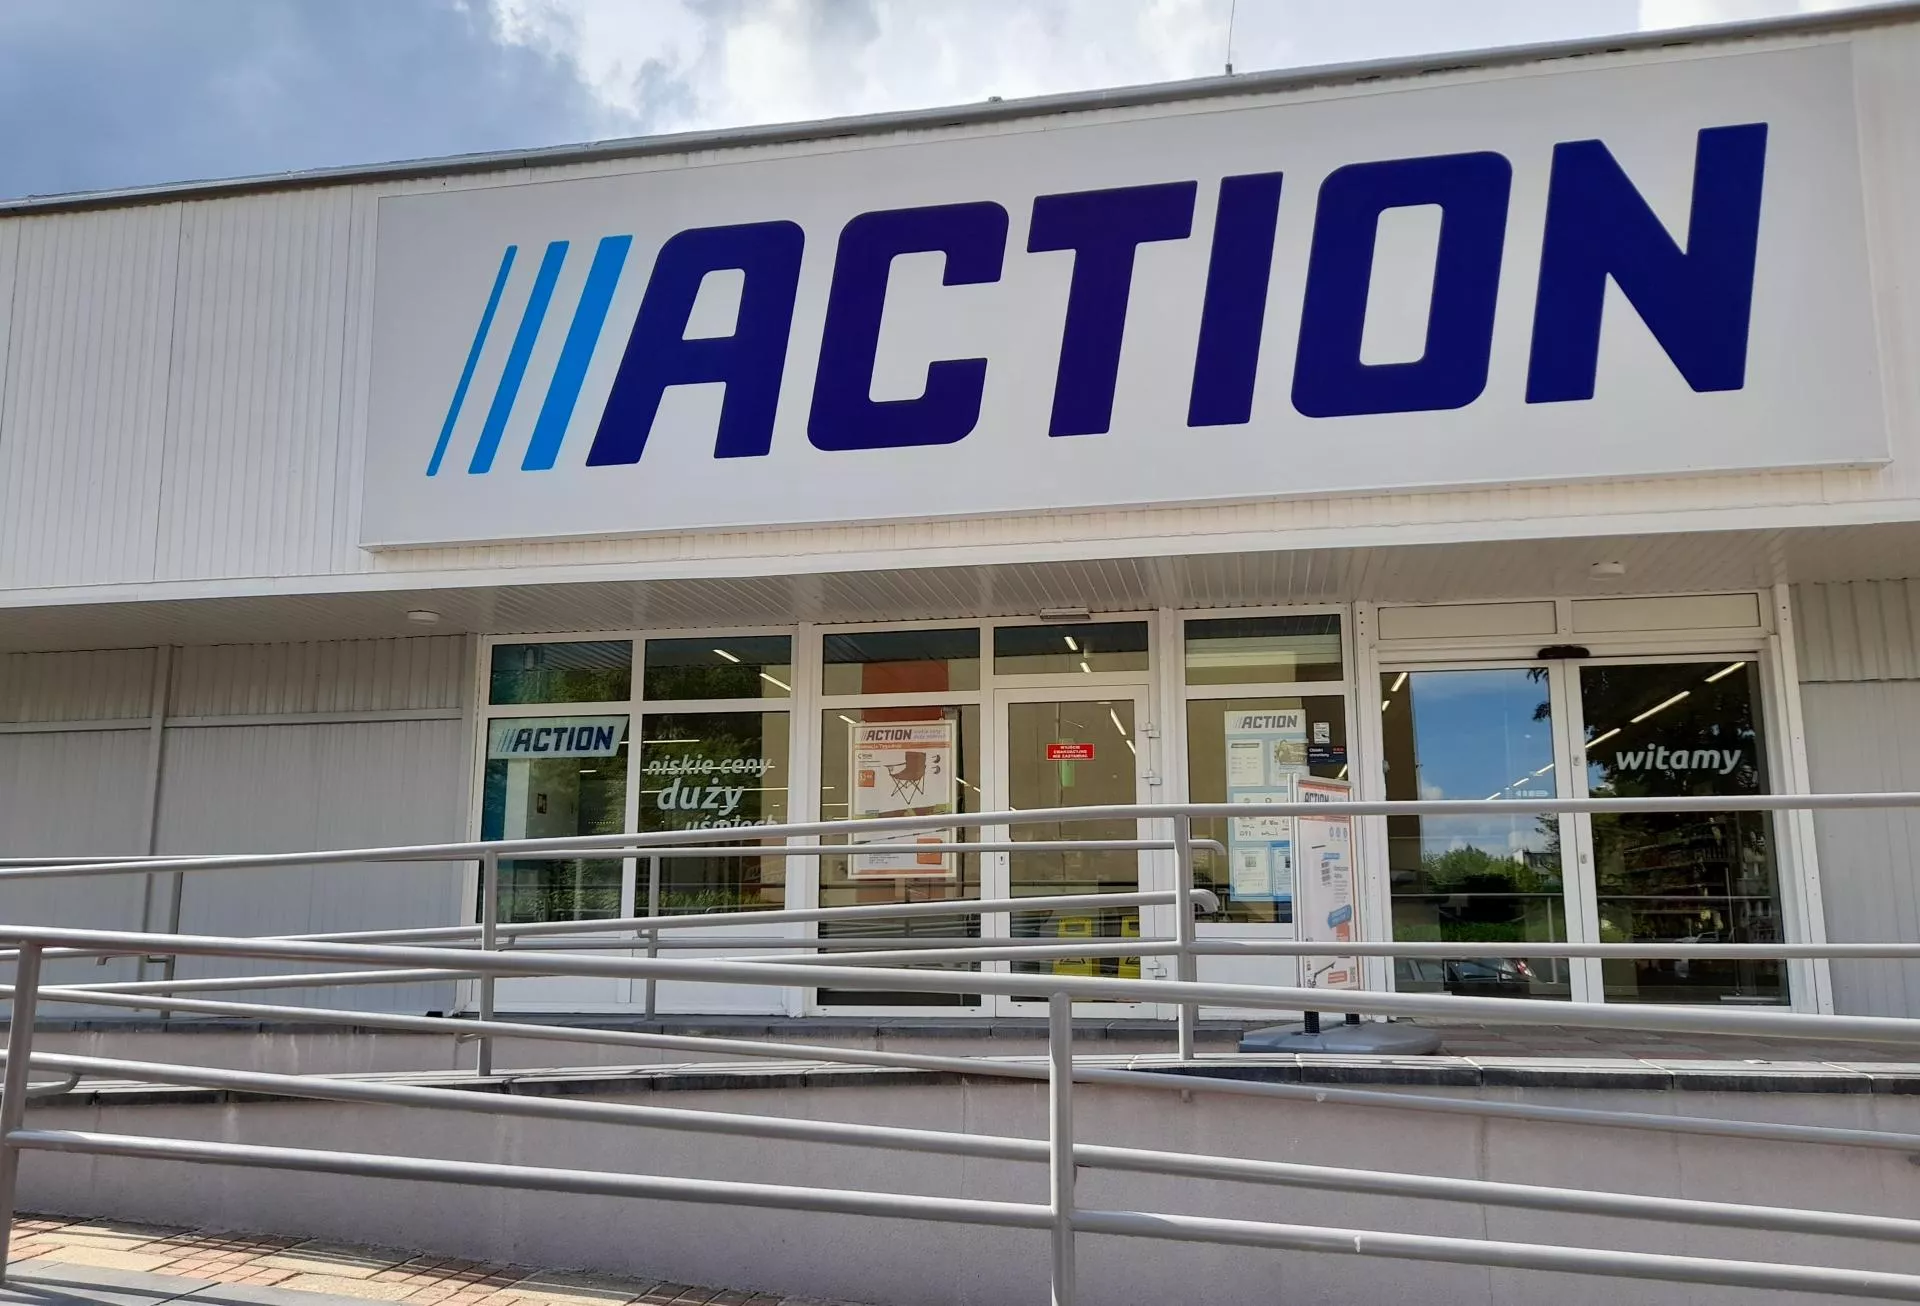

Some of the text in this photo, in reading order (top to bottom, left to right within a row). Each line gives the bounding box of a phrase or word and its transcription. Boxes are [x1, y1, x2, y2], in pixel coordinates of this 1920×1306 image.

[585, 122, 1768, 467] ACTION
[866, 729, 912, 741] ACTION
[1241, 715, 1298, 729] ACTION
[511, 725, 615, 752] ACTION
[647, 754, 772, 778] niskie ceny
[1615, 743, 1742, 775] witamy
[657, 777, 744, 816] duży
